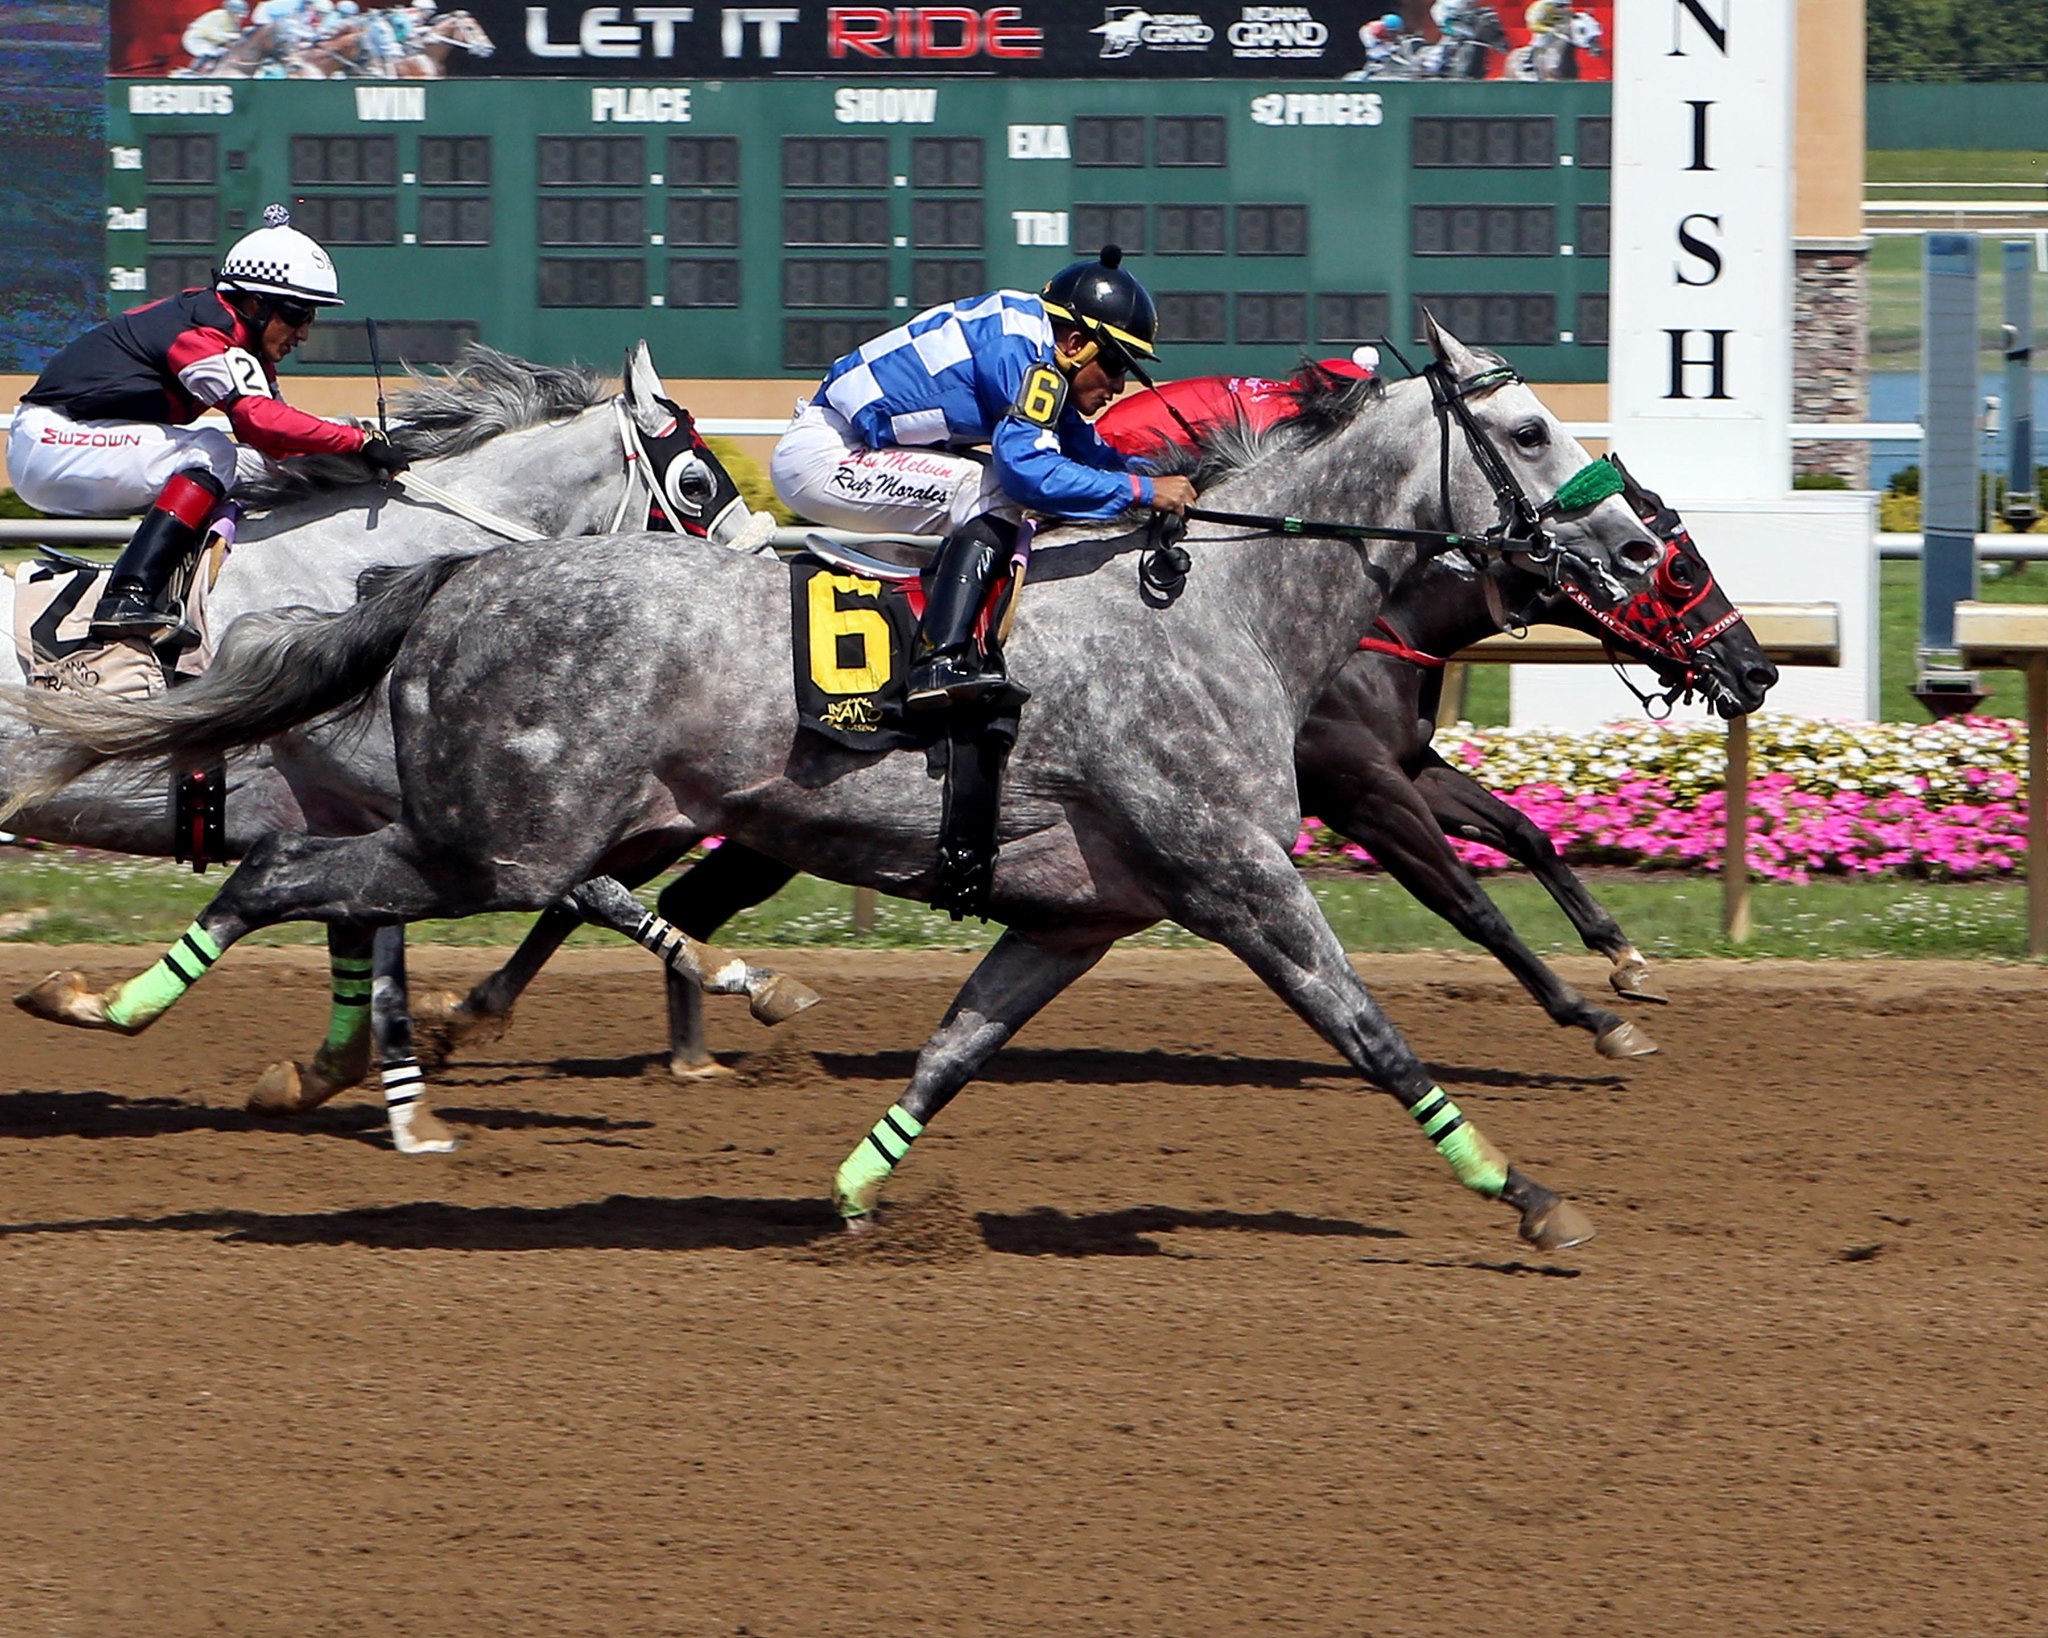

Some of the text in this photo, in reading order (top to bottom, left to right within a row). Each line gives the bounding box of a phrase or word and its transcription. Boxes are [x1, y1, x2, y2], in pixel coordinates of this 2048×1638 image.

[525, 6, 1044, 59] LET IT RIDE
[1227, 21, 1328, 47] GRAND
[129, 84, 234, 115] RESULTS
[355, 86, 426, 121] WIN
[591, 87, 692, 123] PLACE
[834, 87, 937, 123] SHOW
[110, 146, 142, 169] 1st
[1008, 124, 1072, 160] EXA
[106, 206, 148, 231] 2nd
[1011, 211, 1069, 246] TRI
[109, 266, 147, 291] 3rd
[235, 356, 263, 391] 2
[1023, 369, 1060, 422] 6
[41, 427, 141, 447] MENDEZ
[883, 450, 953, 479] Melvin
[874, 473, 948, 503] Morales
[29, 567, 105, 660] 2
[807, 570, 891, 695] 6
